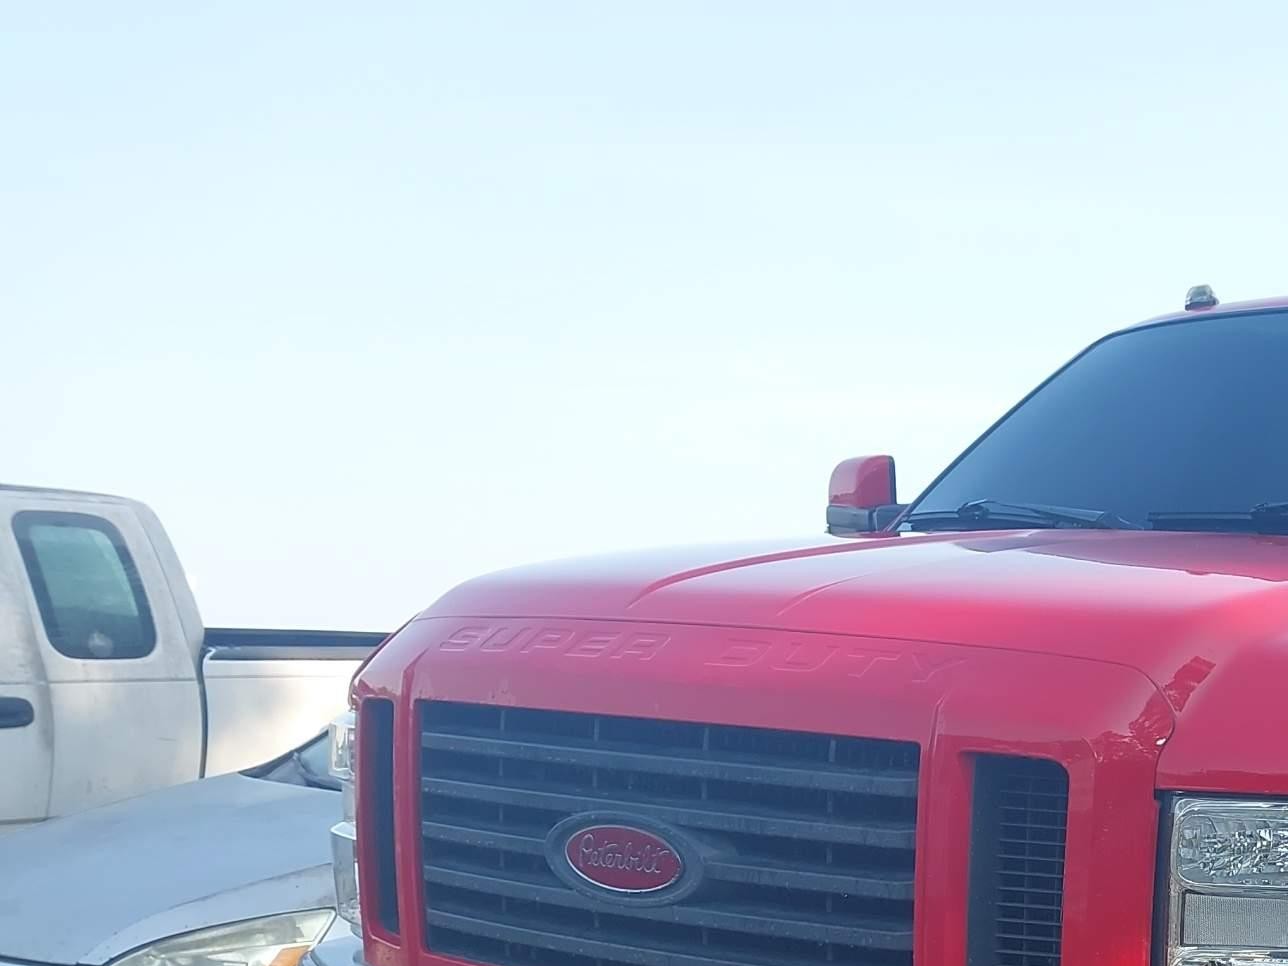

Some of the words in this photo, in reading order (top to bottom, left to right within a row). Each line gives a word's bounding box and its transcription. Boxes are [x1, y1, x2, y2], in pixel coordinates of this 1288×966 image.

[439, 625, 672, 661] SUPER
[703, 637, 968, 683] DUTY
[579, 834, 670, 874] Peterbilt
